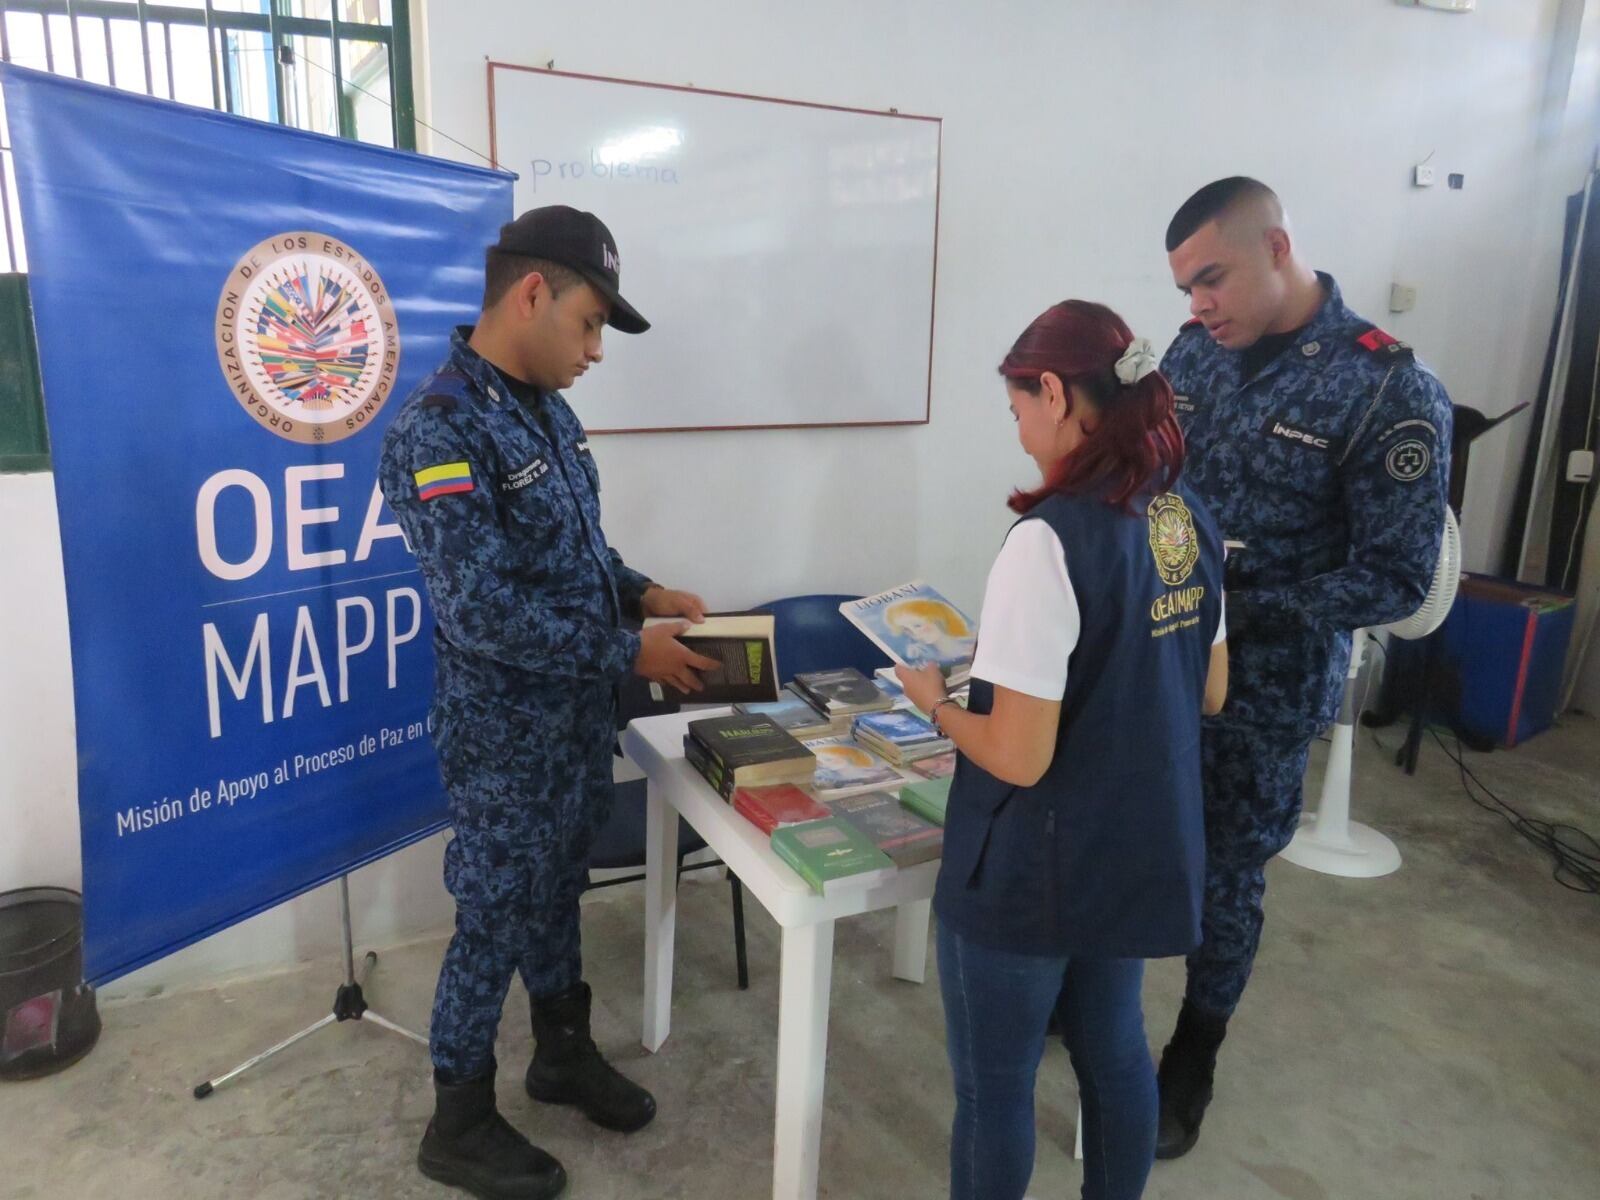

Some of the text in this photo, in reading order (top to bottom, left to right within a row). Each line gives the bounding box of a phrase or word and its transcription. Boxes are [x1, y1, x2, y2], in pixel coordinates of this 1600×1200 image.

[531, 147, 679, 193] problema
[222, 237, 396, 433] ORGANIZACION DE LOS ESTADOS AMERICANOS
[196, 463, 413, 581] OEA
[203, 587, 421, 738] MAPP
[117, 797, 183, 837] Misión
[190, 788, 211, 813] de
[217, 771, 268, 806] Apoyo
[274, 760, 289, 783] al
[295, 744, 354, 778] Proceso
[359, 734, 376, 756] de
[381, 725, 404, 749] Paz
[407, 721, 422, 740] en
